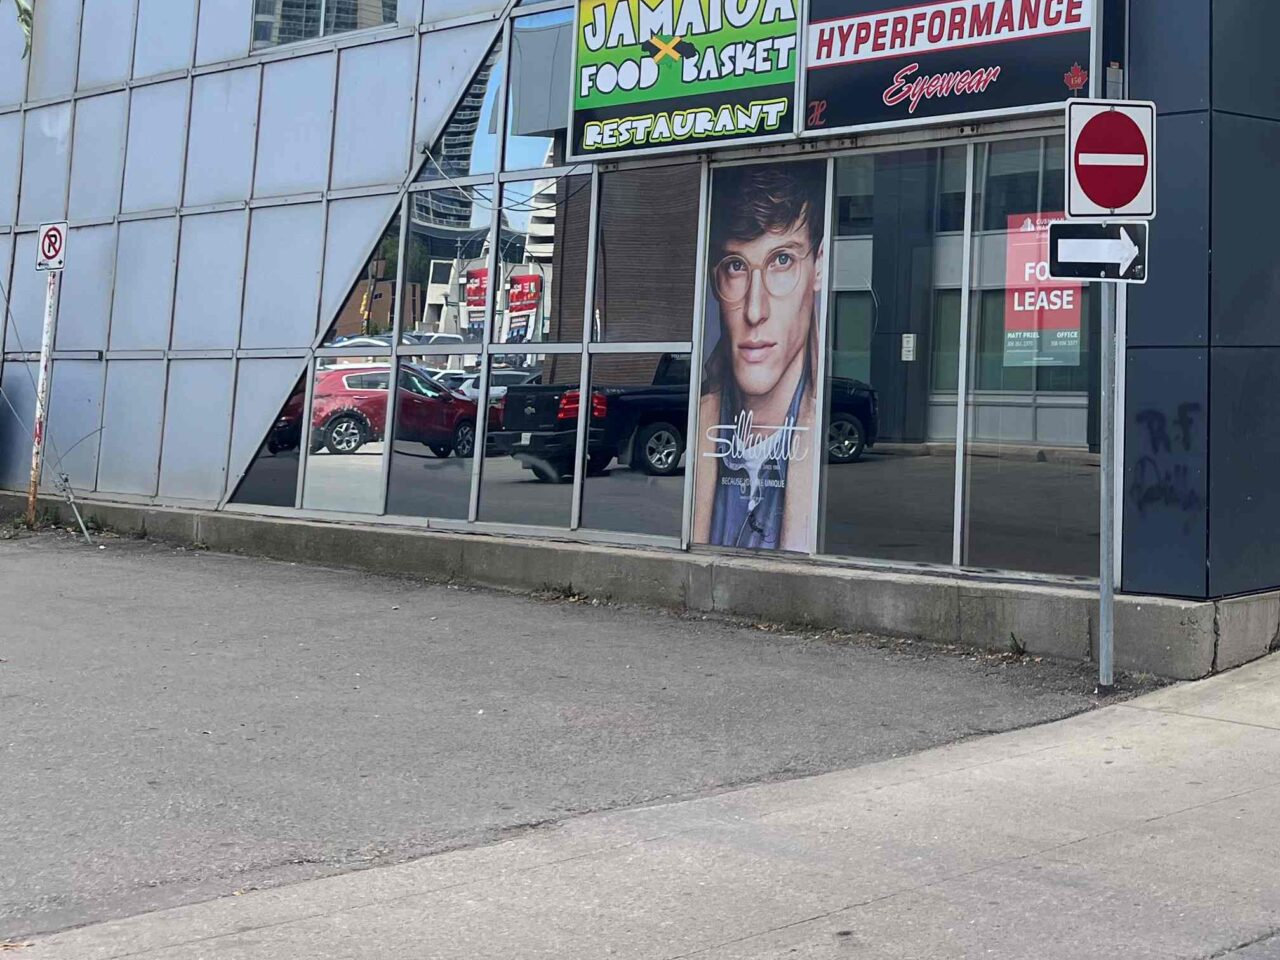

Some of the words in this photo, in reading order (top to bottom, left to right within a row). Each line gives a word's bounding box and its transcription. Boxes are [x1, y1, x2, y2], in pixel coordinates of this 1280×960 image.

[580, 57, 659, 97] FOOD
[682, 34, 796, 82] BASKET
[883, 63, 1001, 113] Eyewear
[583, 98, 788, 148] RESTAURANT
[1024, 261, 1050, 282] FO
[1014, 290, 1074, 311] LEASE
[721, 477, 743, 486] BECAUSE
[764, 479, 785, 488] UNIQUE
